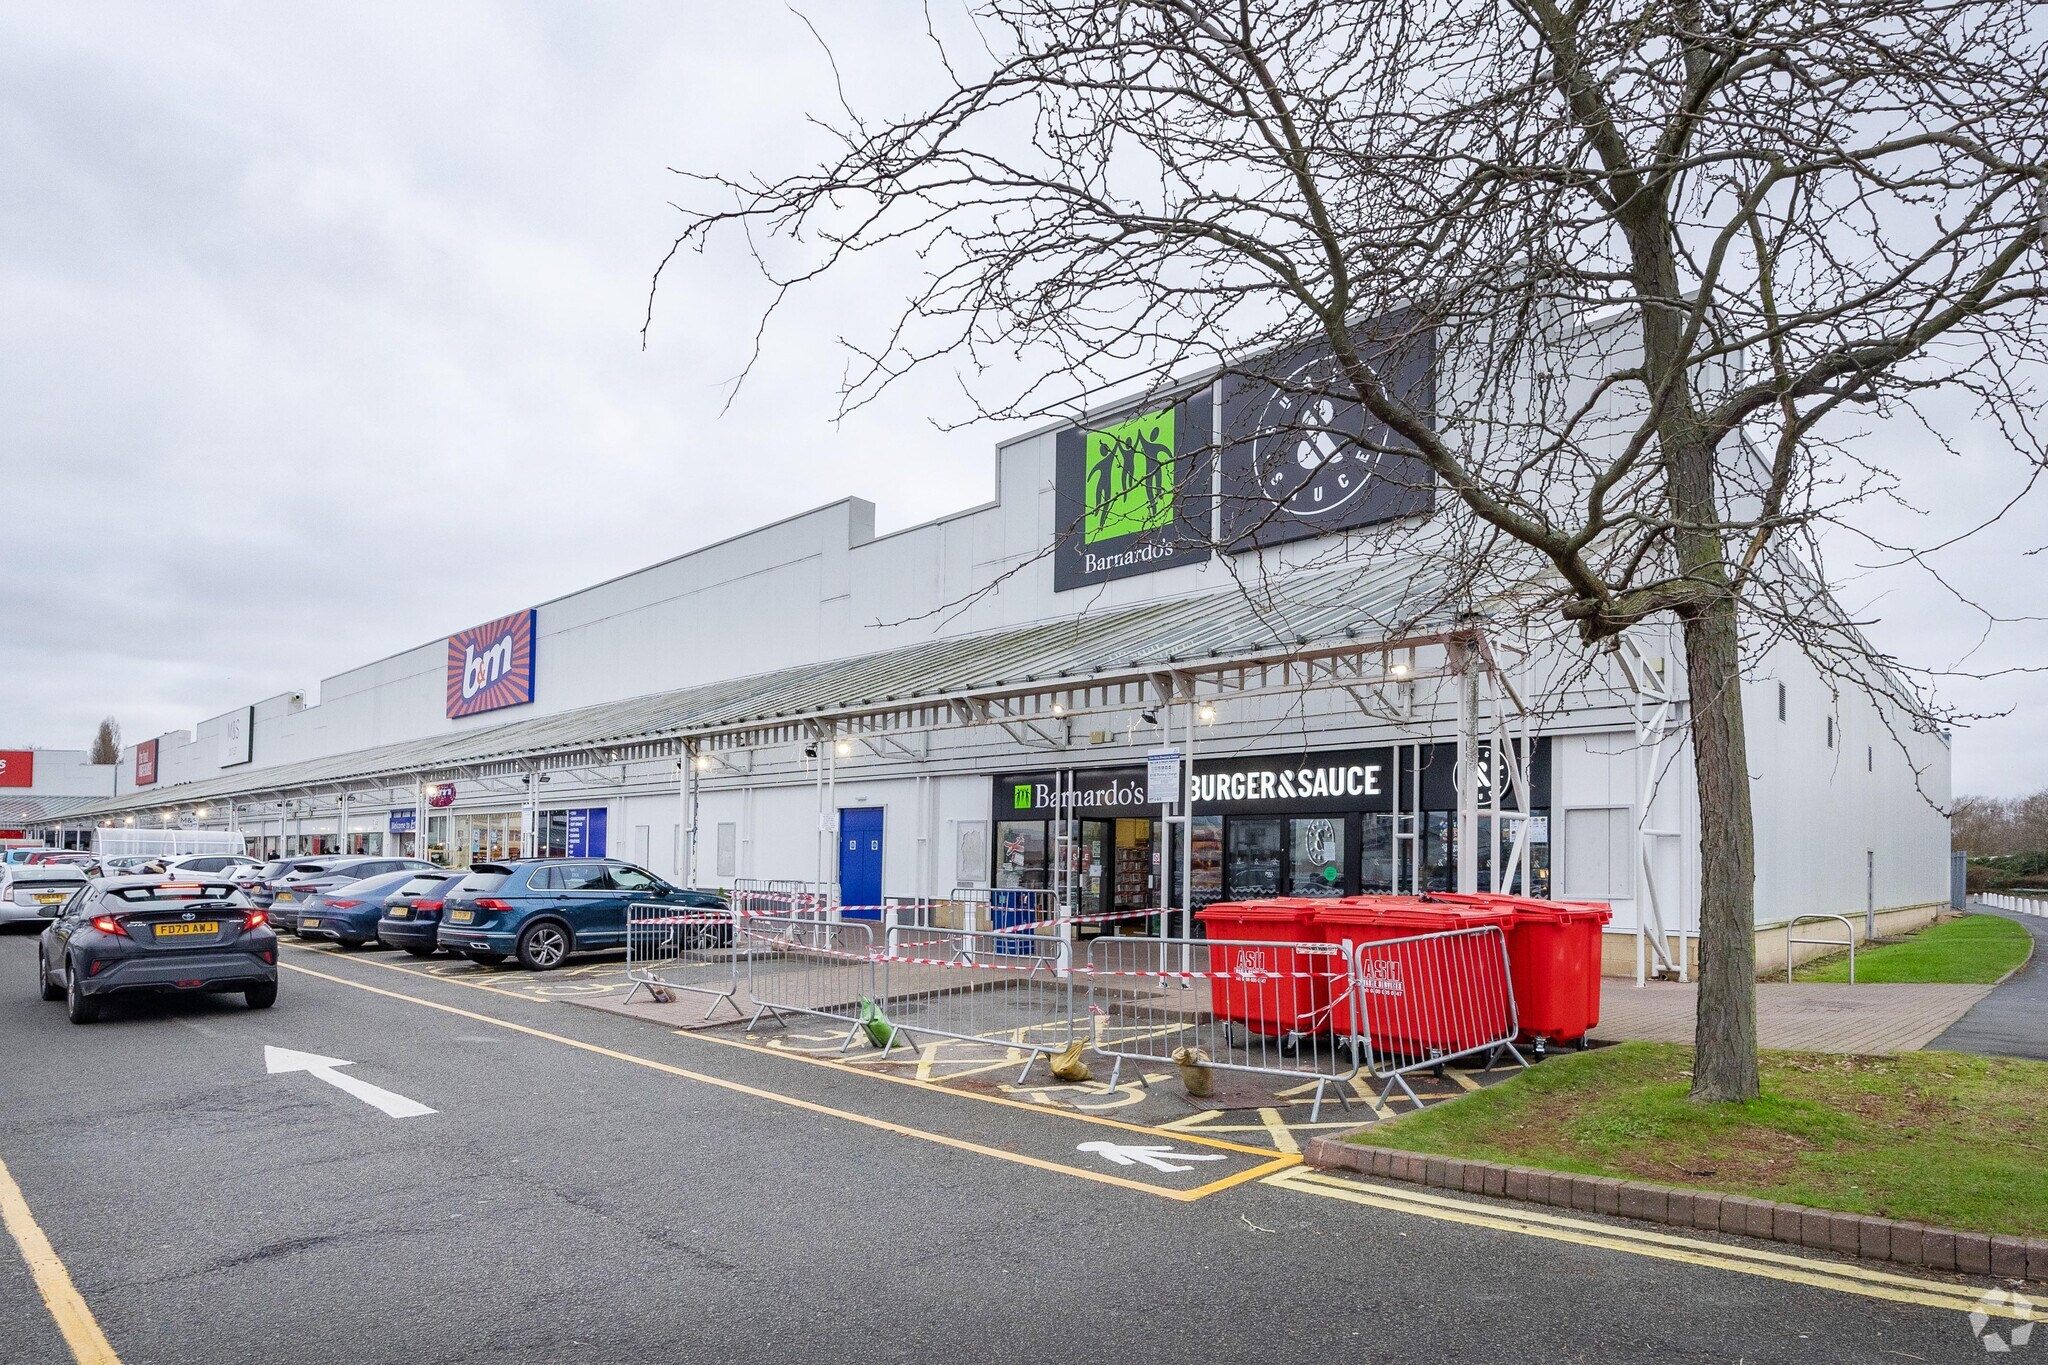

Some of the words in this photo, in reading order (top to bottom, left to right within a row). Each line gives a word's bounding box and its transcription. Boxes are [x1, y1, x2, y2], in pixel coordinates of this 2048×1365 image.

[1085, 538, 1173, 574] Barnardo's
[463, 635, 512, 699] b&m
[1035, 779, 1144, 808] Barnardo's
[161, 924, 189, 934] FD70
[192, 922, 214, 933] AWJ
[1363, 959, 1400, 981] ASH
